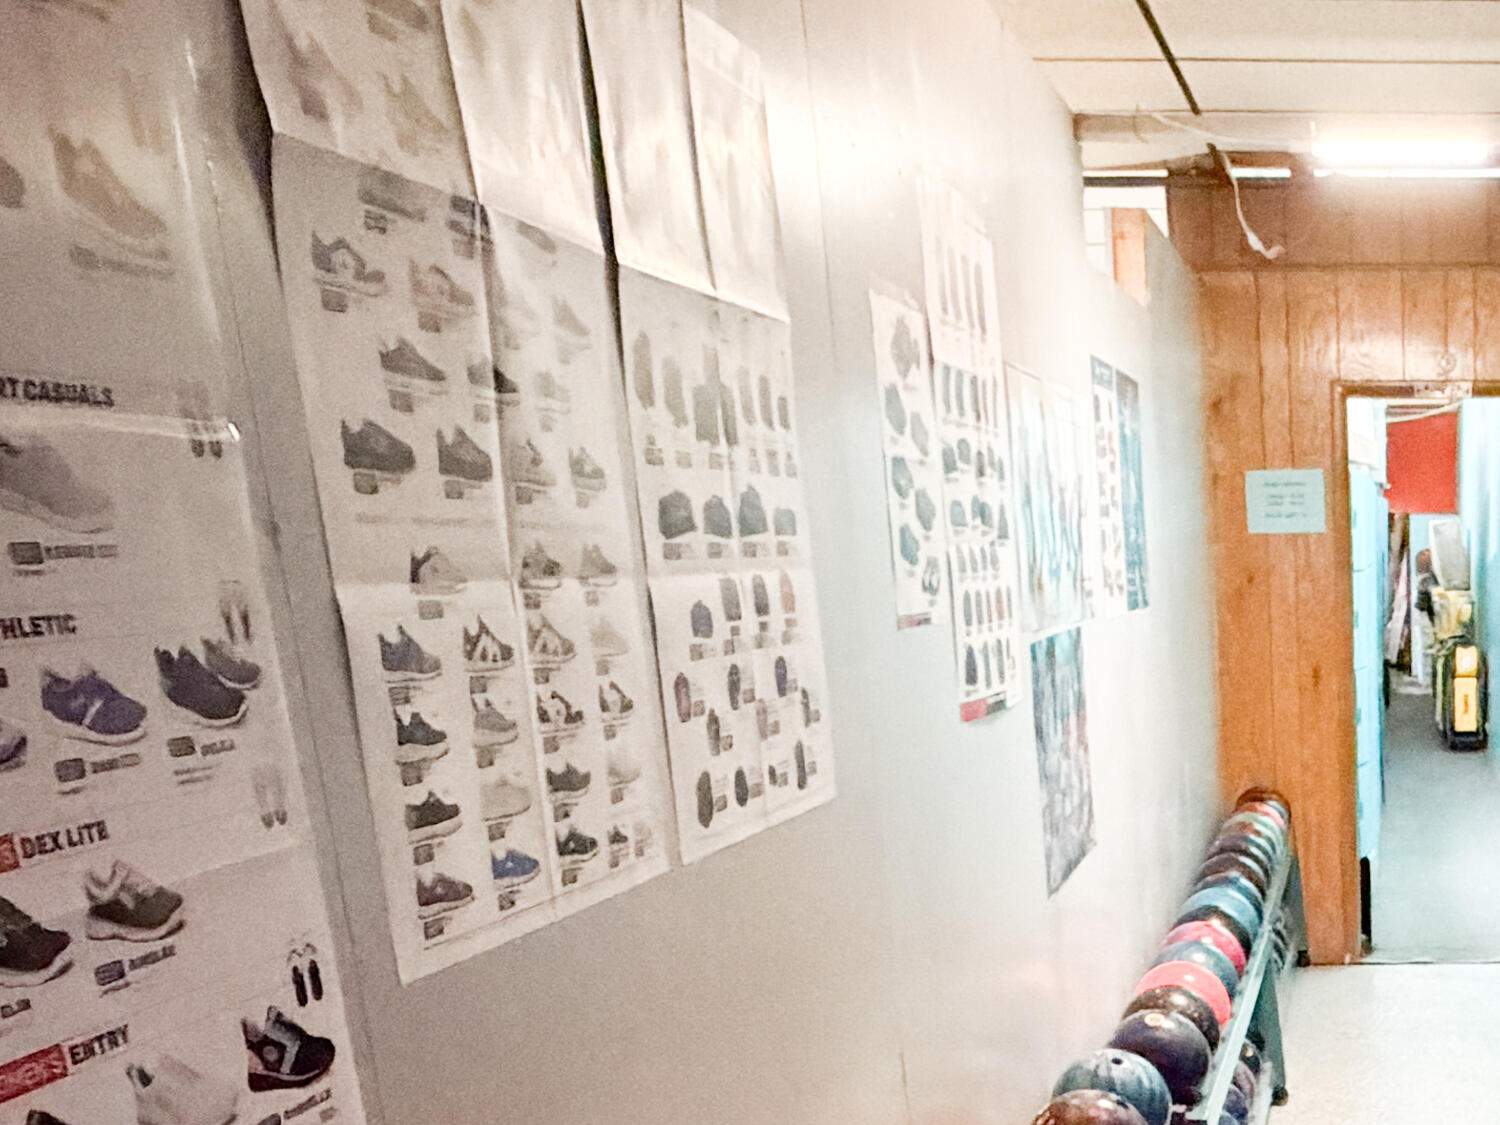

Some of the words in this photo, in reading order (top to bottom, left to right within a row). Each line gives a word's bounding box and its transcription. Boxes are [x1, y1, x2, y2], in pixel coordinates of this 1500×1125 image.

[0, 614, 76, 639] HLETIC
[20, 830, 65, 859] DEX
[65, 819, 110, 848] LITE
[68, 1023, 128, 1065] ENTRY
